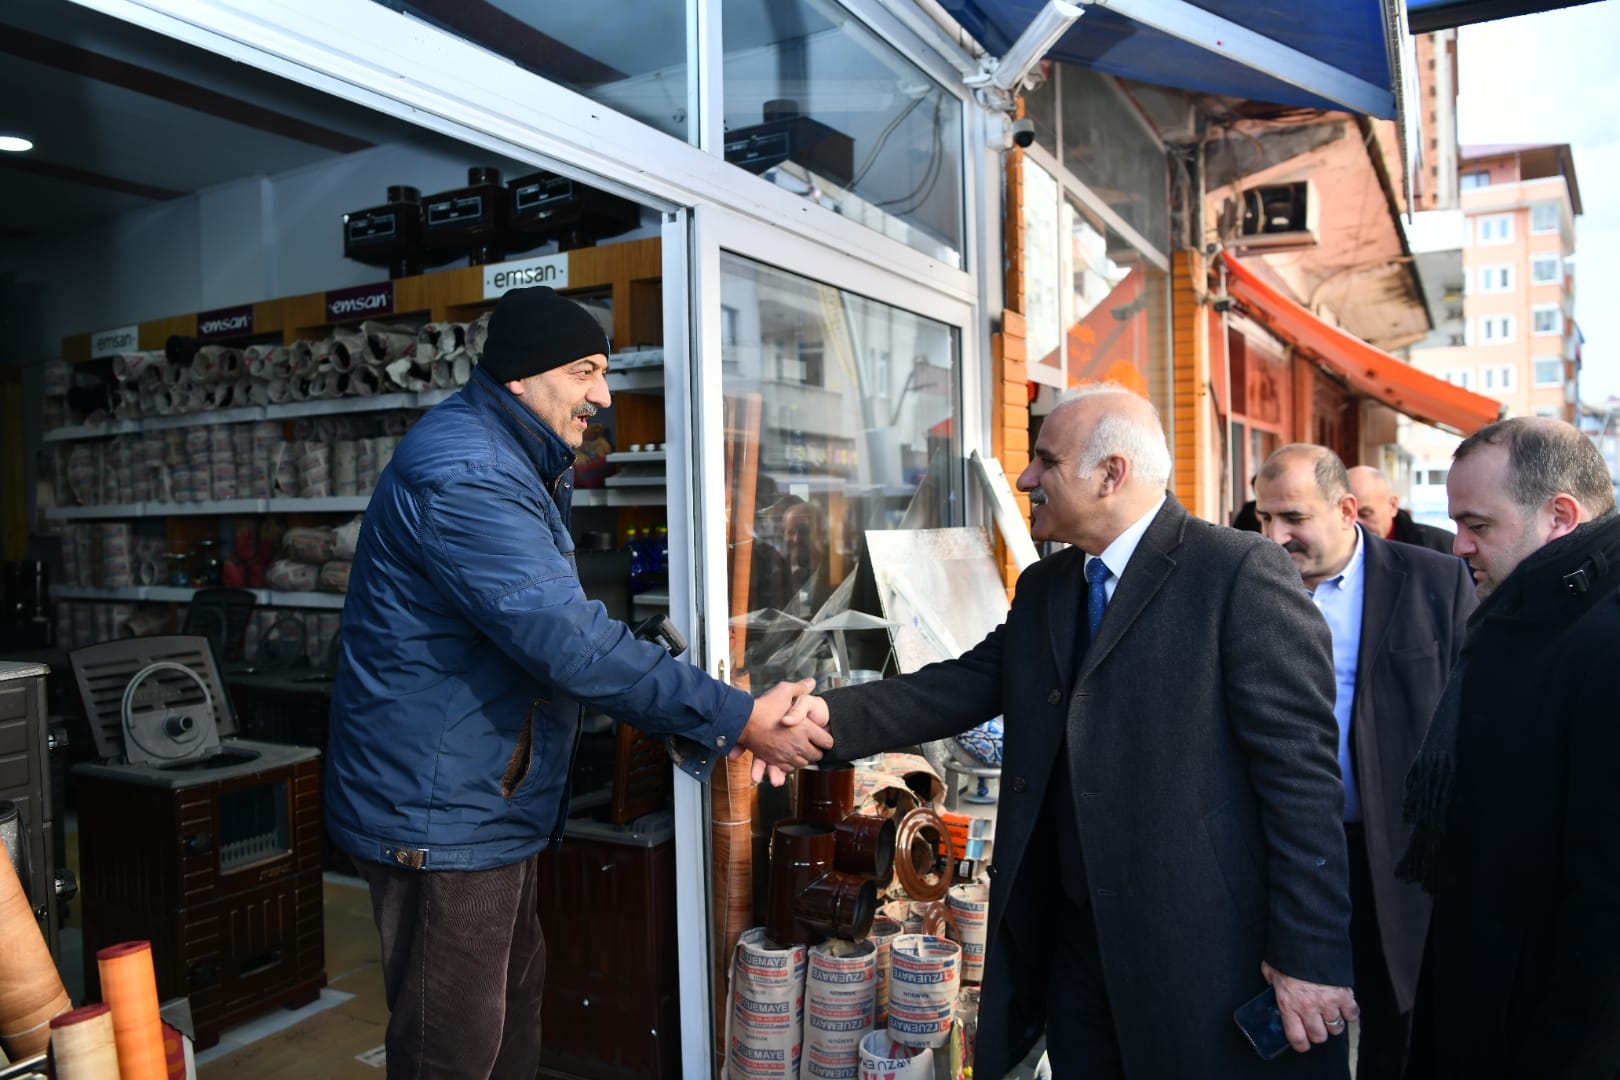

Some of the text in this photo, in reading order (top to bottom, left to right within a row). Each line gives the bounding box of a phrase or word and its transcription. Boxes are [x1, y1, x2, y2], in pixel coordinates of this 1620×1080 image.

[493, 264, 556, 288] emsan
[332, 293, 387, 314] emsan
[201, 315, 248, 335] emsan
[96, 333, 132, 352] emsan
